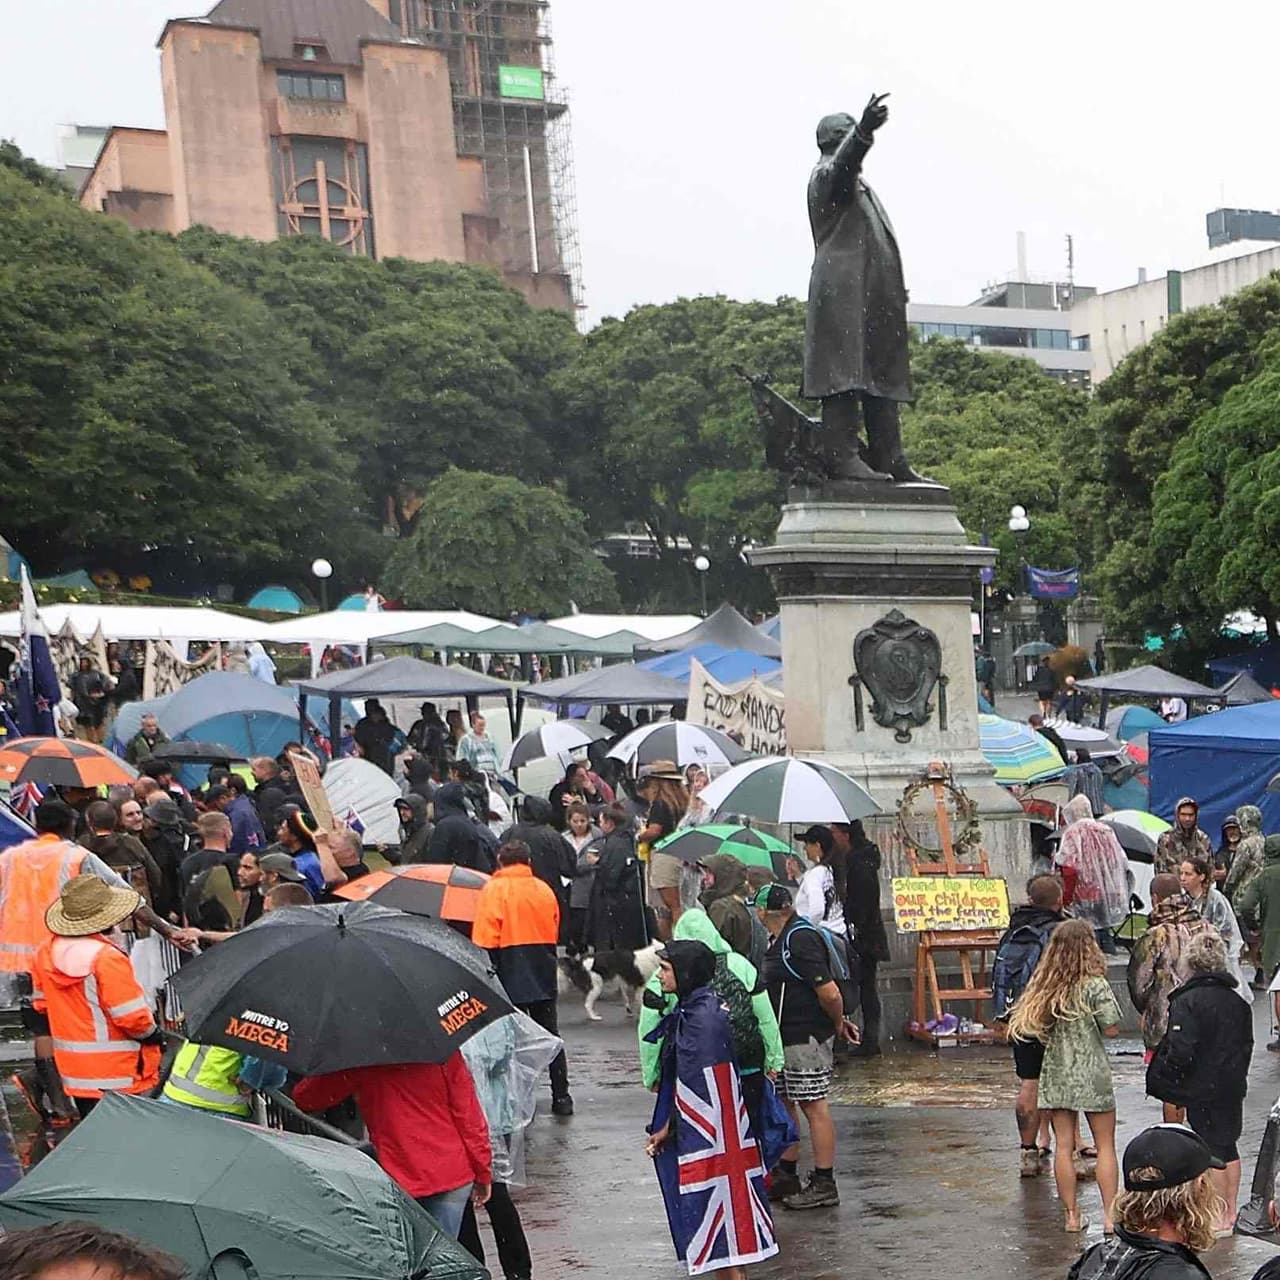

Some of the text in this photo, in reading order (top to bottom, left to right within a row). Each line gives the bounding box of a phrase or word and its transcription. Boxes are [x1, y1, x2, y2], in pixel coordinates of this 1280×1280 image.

[224, 1016, 289, 1053] MEGA
[241, 1009, 289, 1032] MITRE 10
[440, 998, 489, 1036] MEGA
